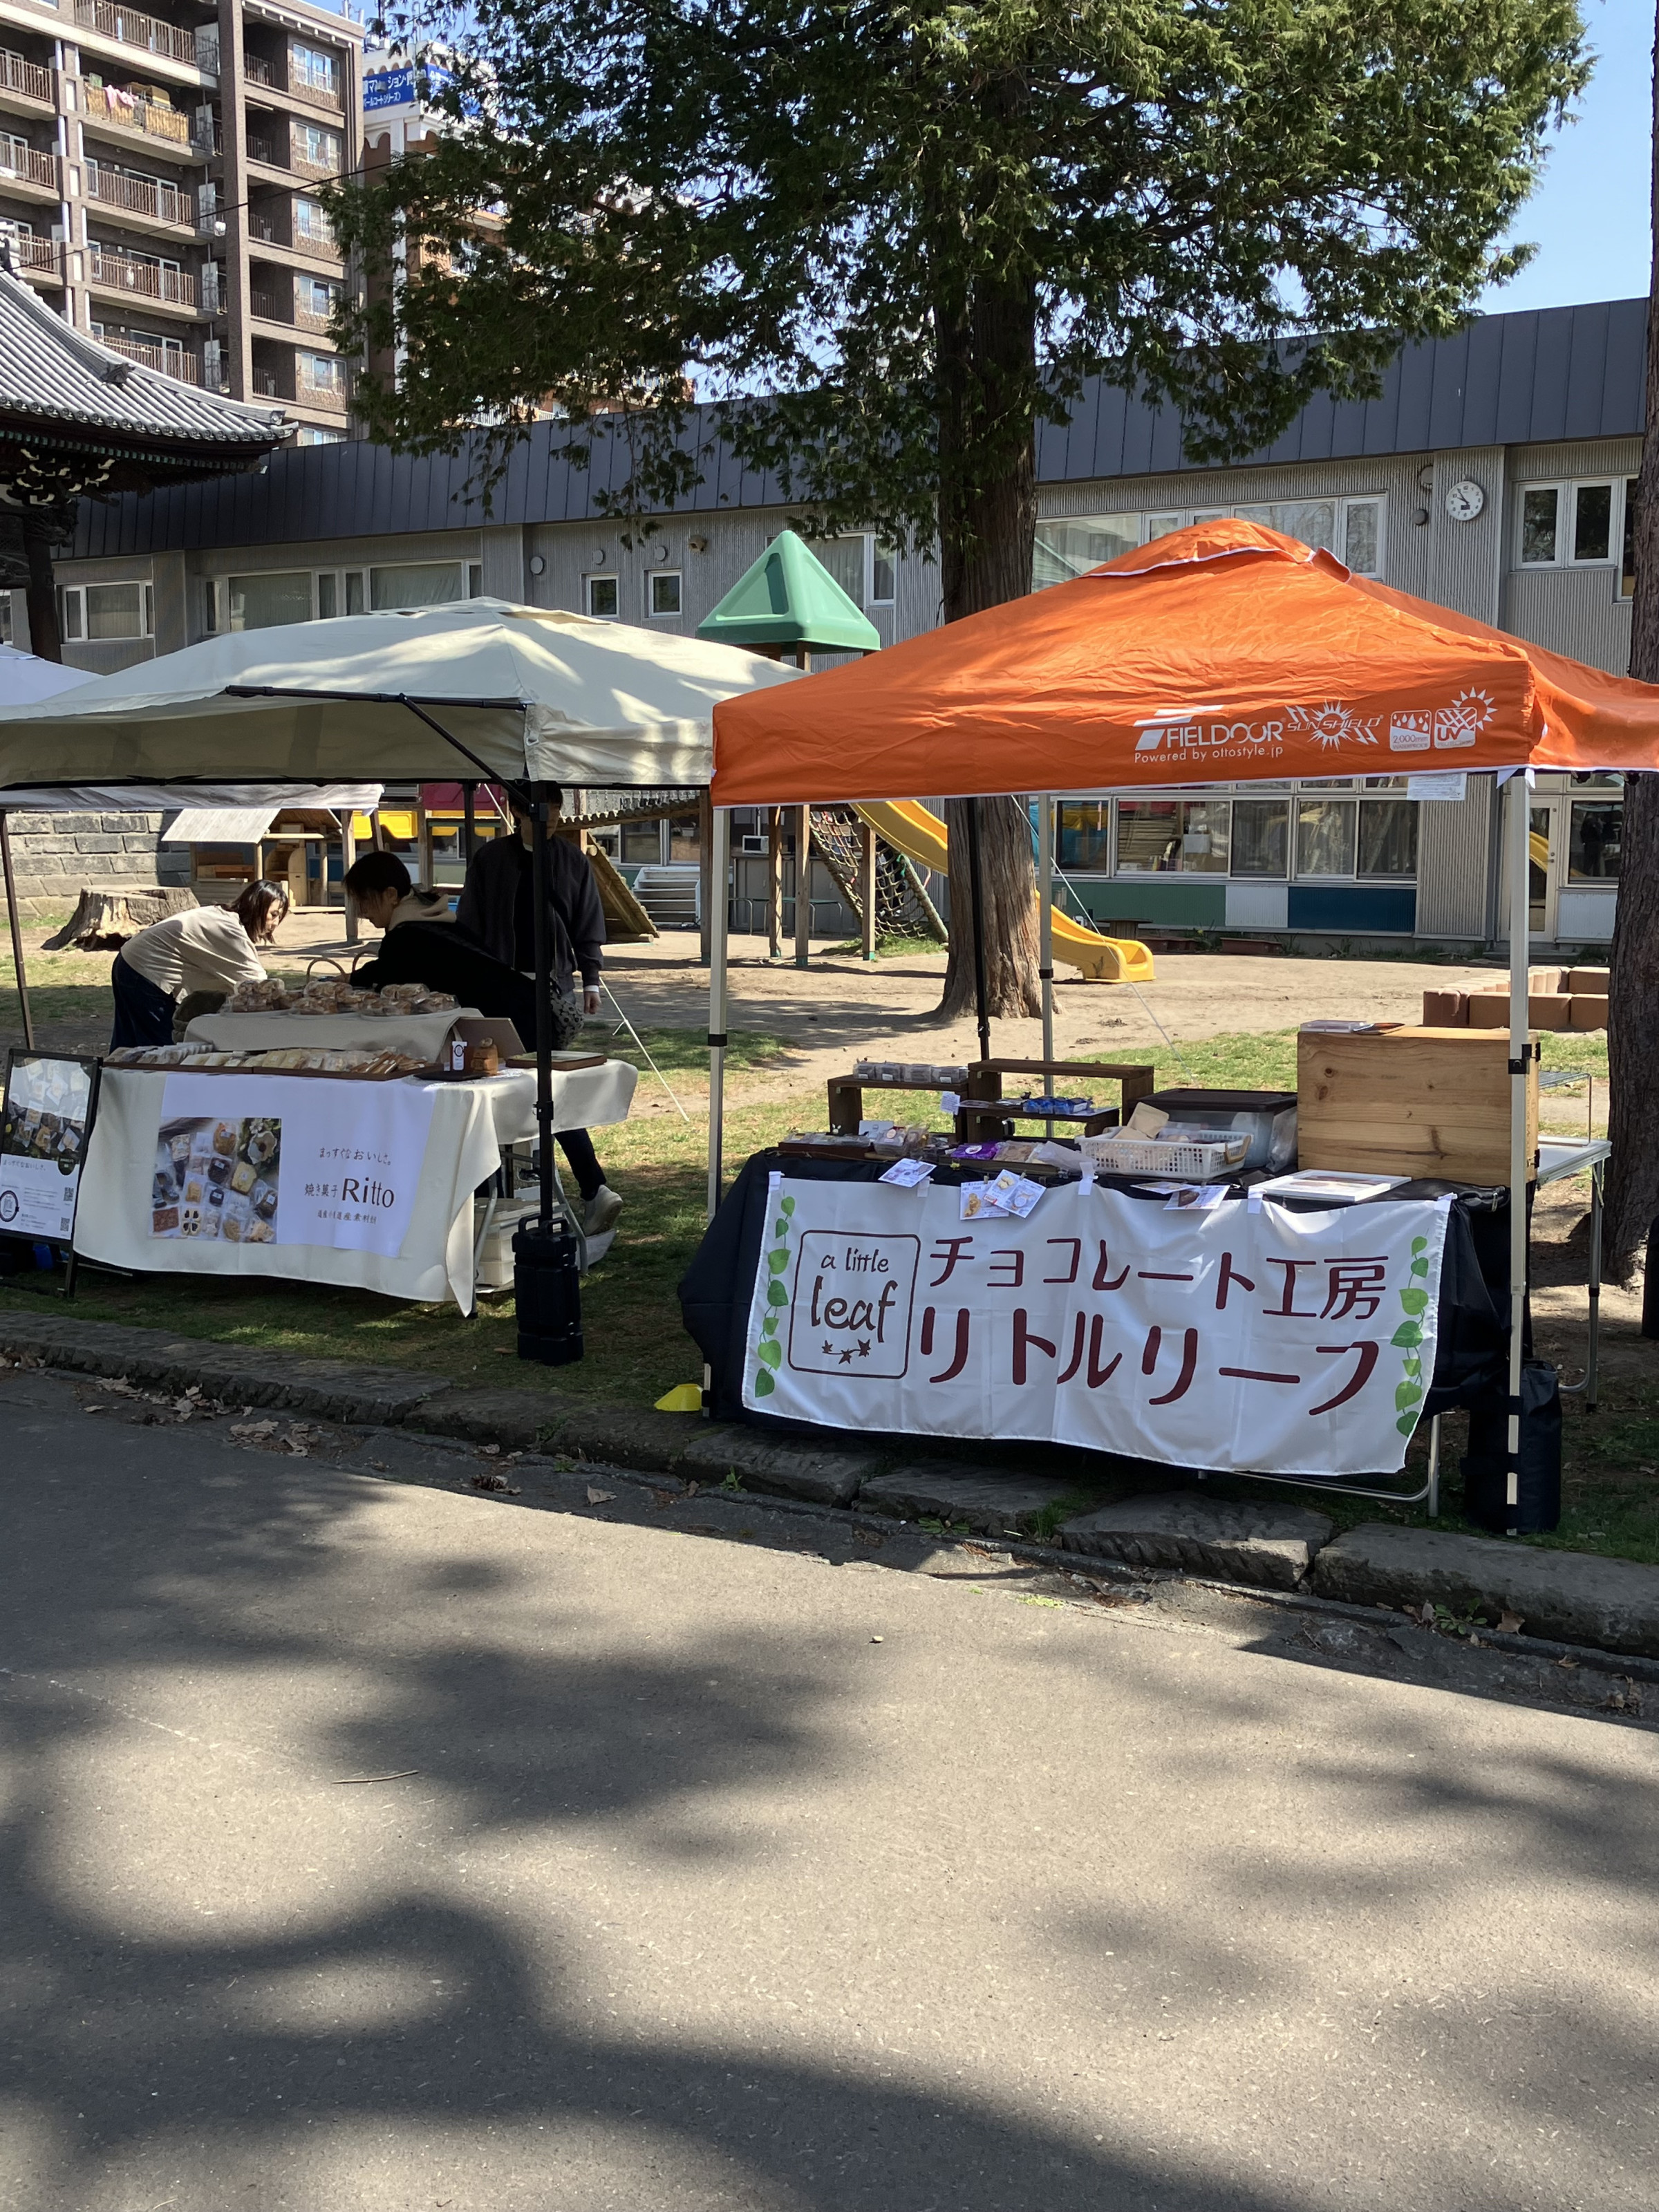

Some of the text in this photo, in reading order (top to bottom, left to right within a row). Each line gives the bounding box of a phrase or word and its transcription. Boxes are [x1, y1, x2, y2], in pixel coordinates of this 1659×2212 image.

[1166, 721, 1284, 748] FIELDOOR
[1286, 718, 1381, 732] SUN SHIELD
[1134, 744, 1284, 763] Powered by ottostyle.jp
[304, 1177, 395, 1208] 焼き菓子 Ritto
[821, 1247, 890, 1273] a little
[929, 1236, 1389, 1320] チョコレート工房
[811, 1275, 899, 1343] leaf
[920, 1306, 1379, 1416] リトルリーフ
